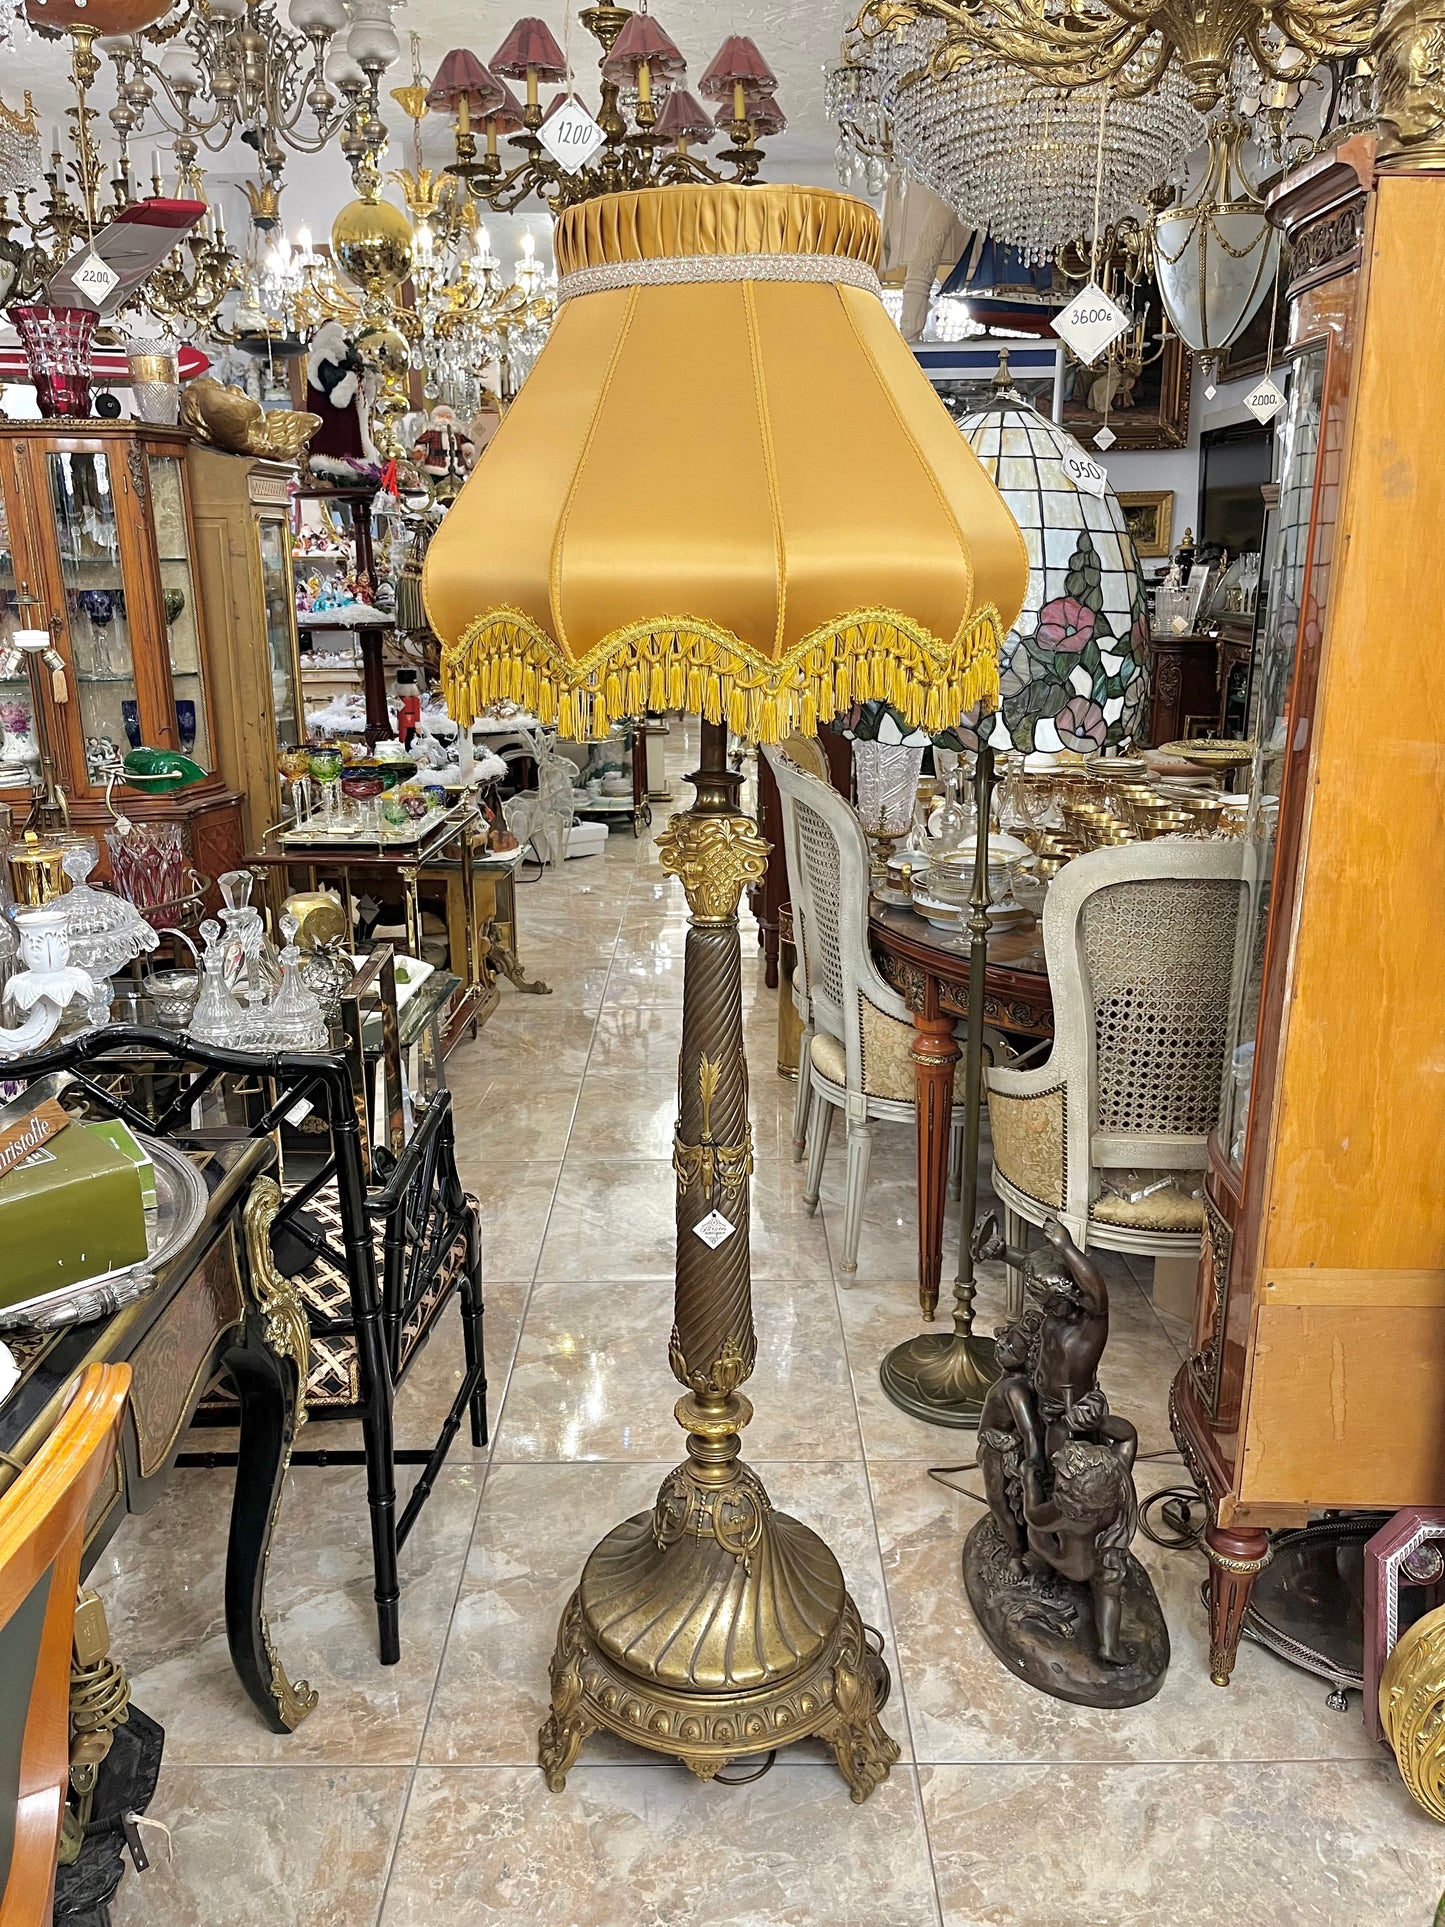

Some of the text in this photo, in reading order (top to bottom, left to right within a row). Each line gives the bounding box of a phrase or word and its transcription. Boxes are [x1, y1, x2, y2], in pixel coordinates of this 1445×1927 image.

[557, 121, 593, 145] 1200
[1071, 308, 1113, 325] 3600€
[1069, 459, 1101, 479] 950
